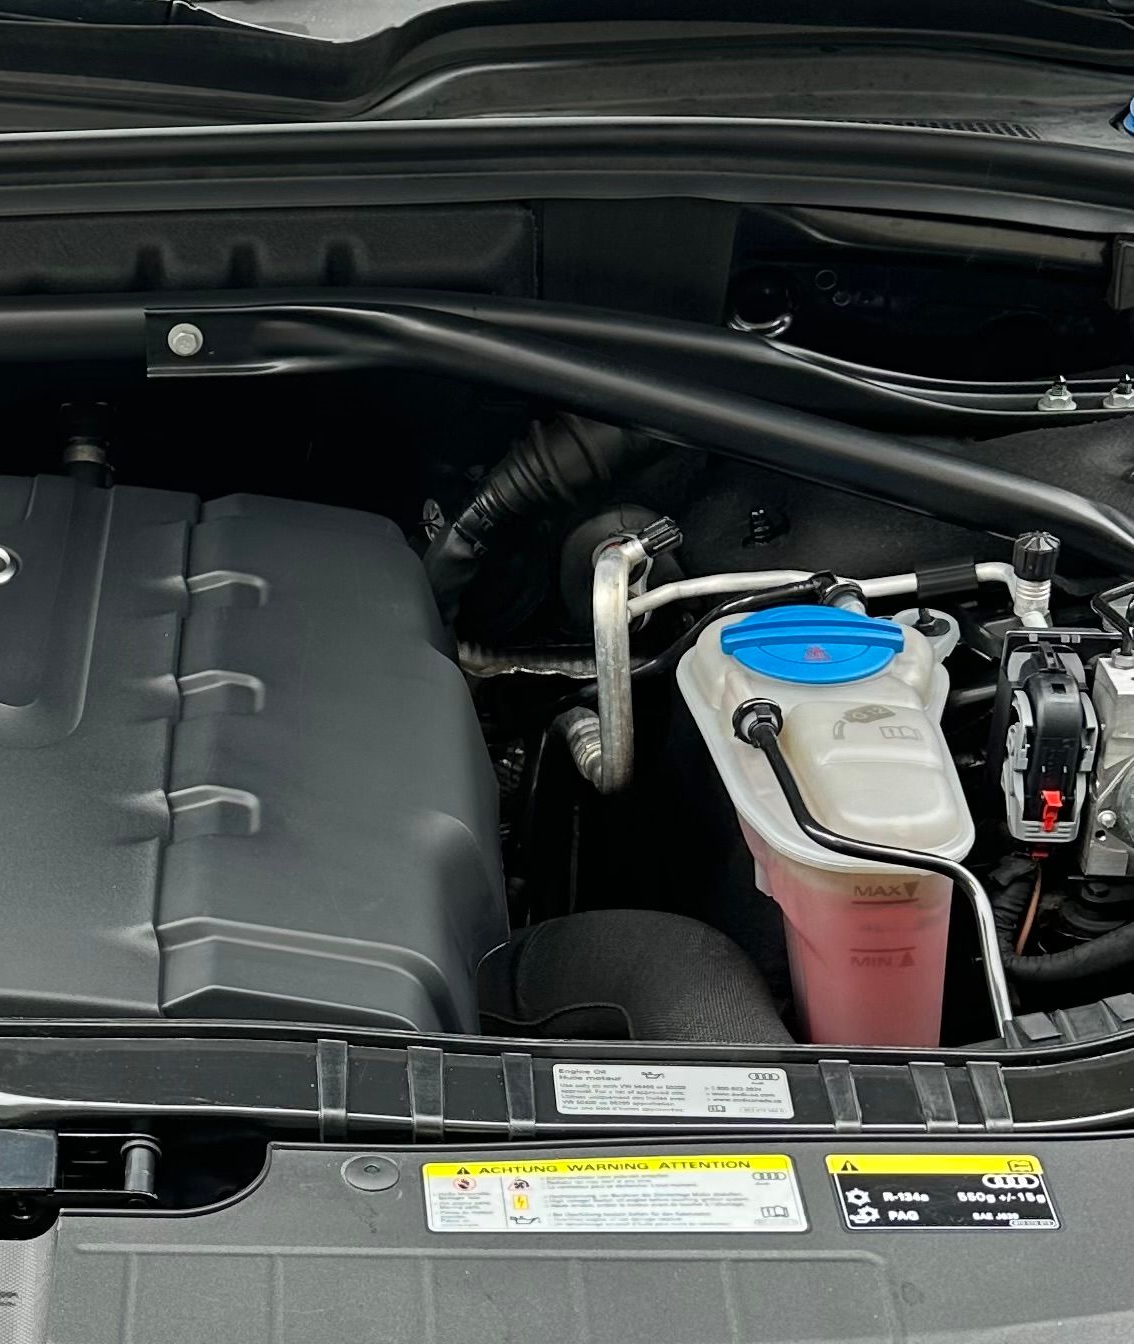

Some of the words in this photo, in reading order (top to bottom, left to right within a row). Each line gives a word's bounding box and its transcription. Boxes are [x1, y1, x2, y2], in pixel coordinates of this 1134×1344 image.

[854, 885, 902, 896] MAX
[850, 957, 893, 967] MIN
[479, 1165, 558, 1174] ACHTUNG
[566, 1162, 649, 1171] WARNING
[658, 1160, 751, 1169] ATTENTION
[882, 1192, 929, 1202] R-134a
[888, 1210, 919, 1221] PAG
